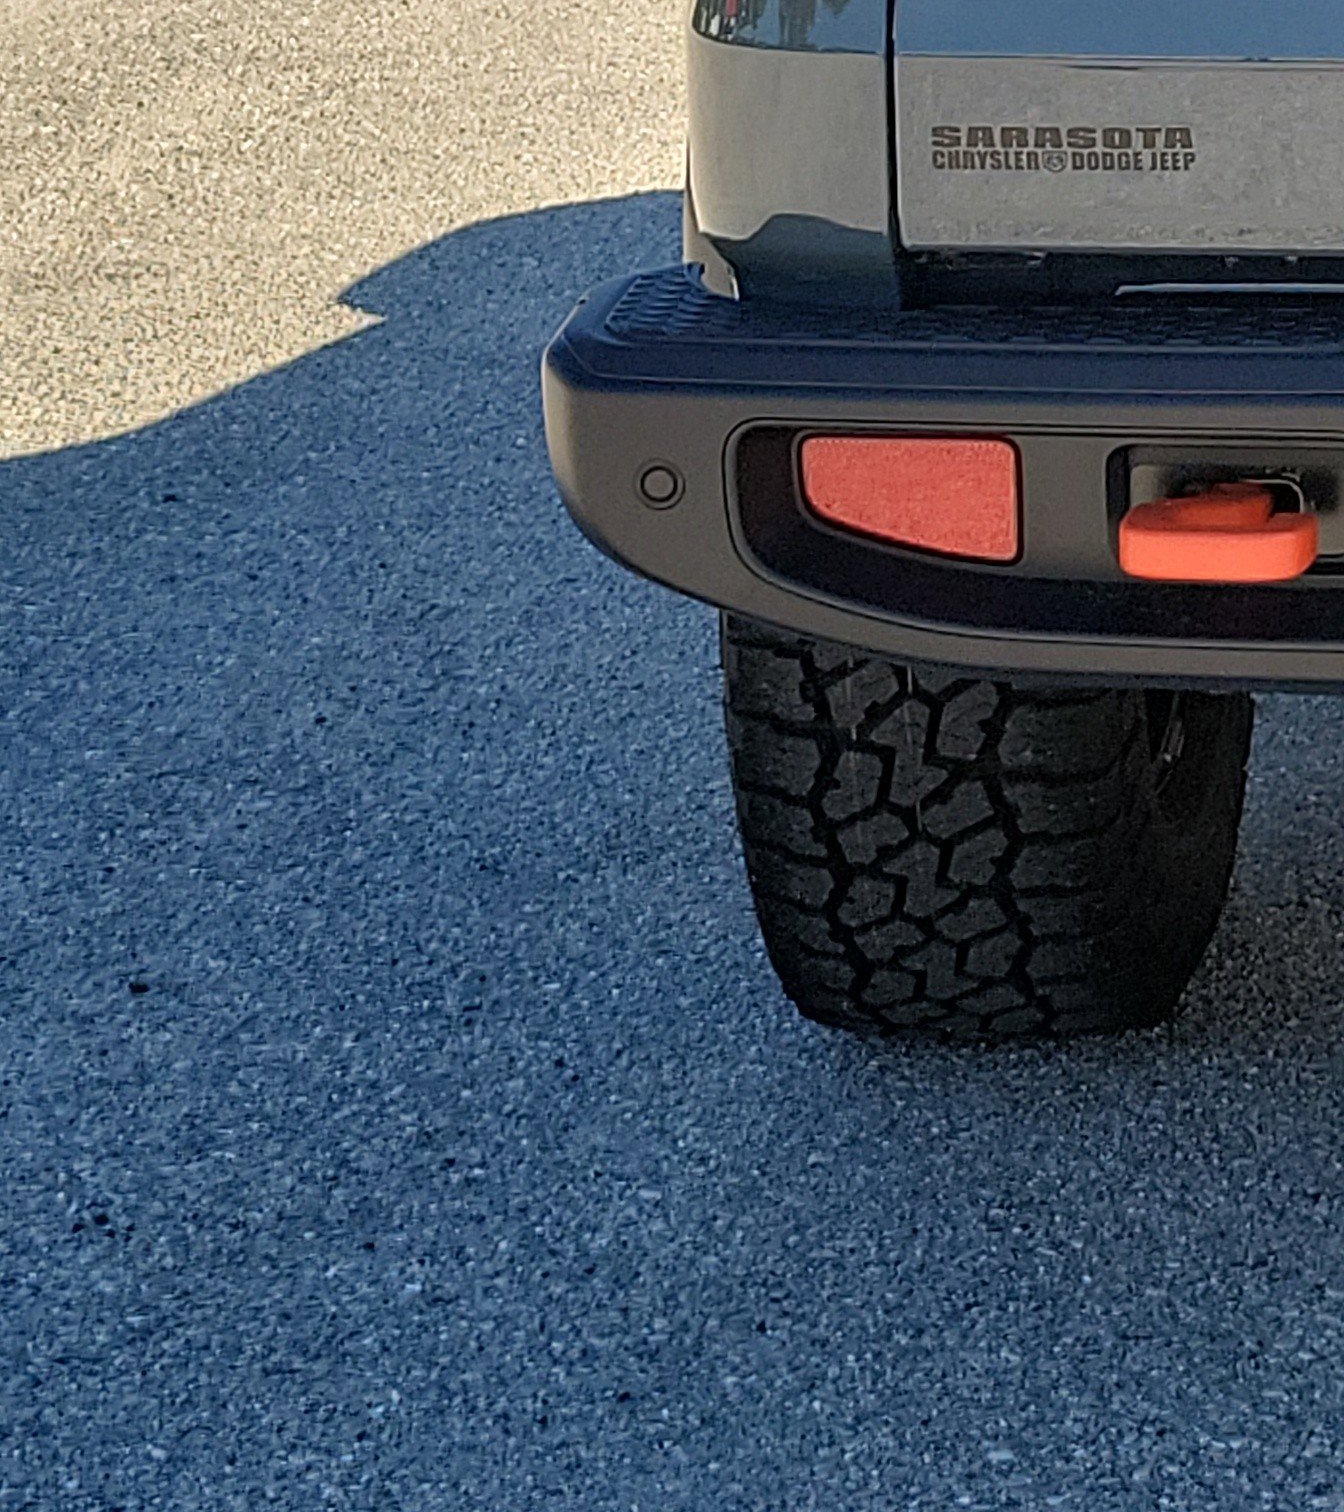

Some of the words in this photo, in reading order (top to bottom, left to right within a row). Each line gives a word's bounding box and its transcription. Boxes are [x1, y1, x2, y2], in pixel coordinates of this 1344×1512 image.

[931, 125, 1194, 149] SARASOTA
[931, 149, 1041, 171] CHRYSLER
[1072, 151, 1143, 172] DODGE
[1149, 152, 1196, 172] JEEP
